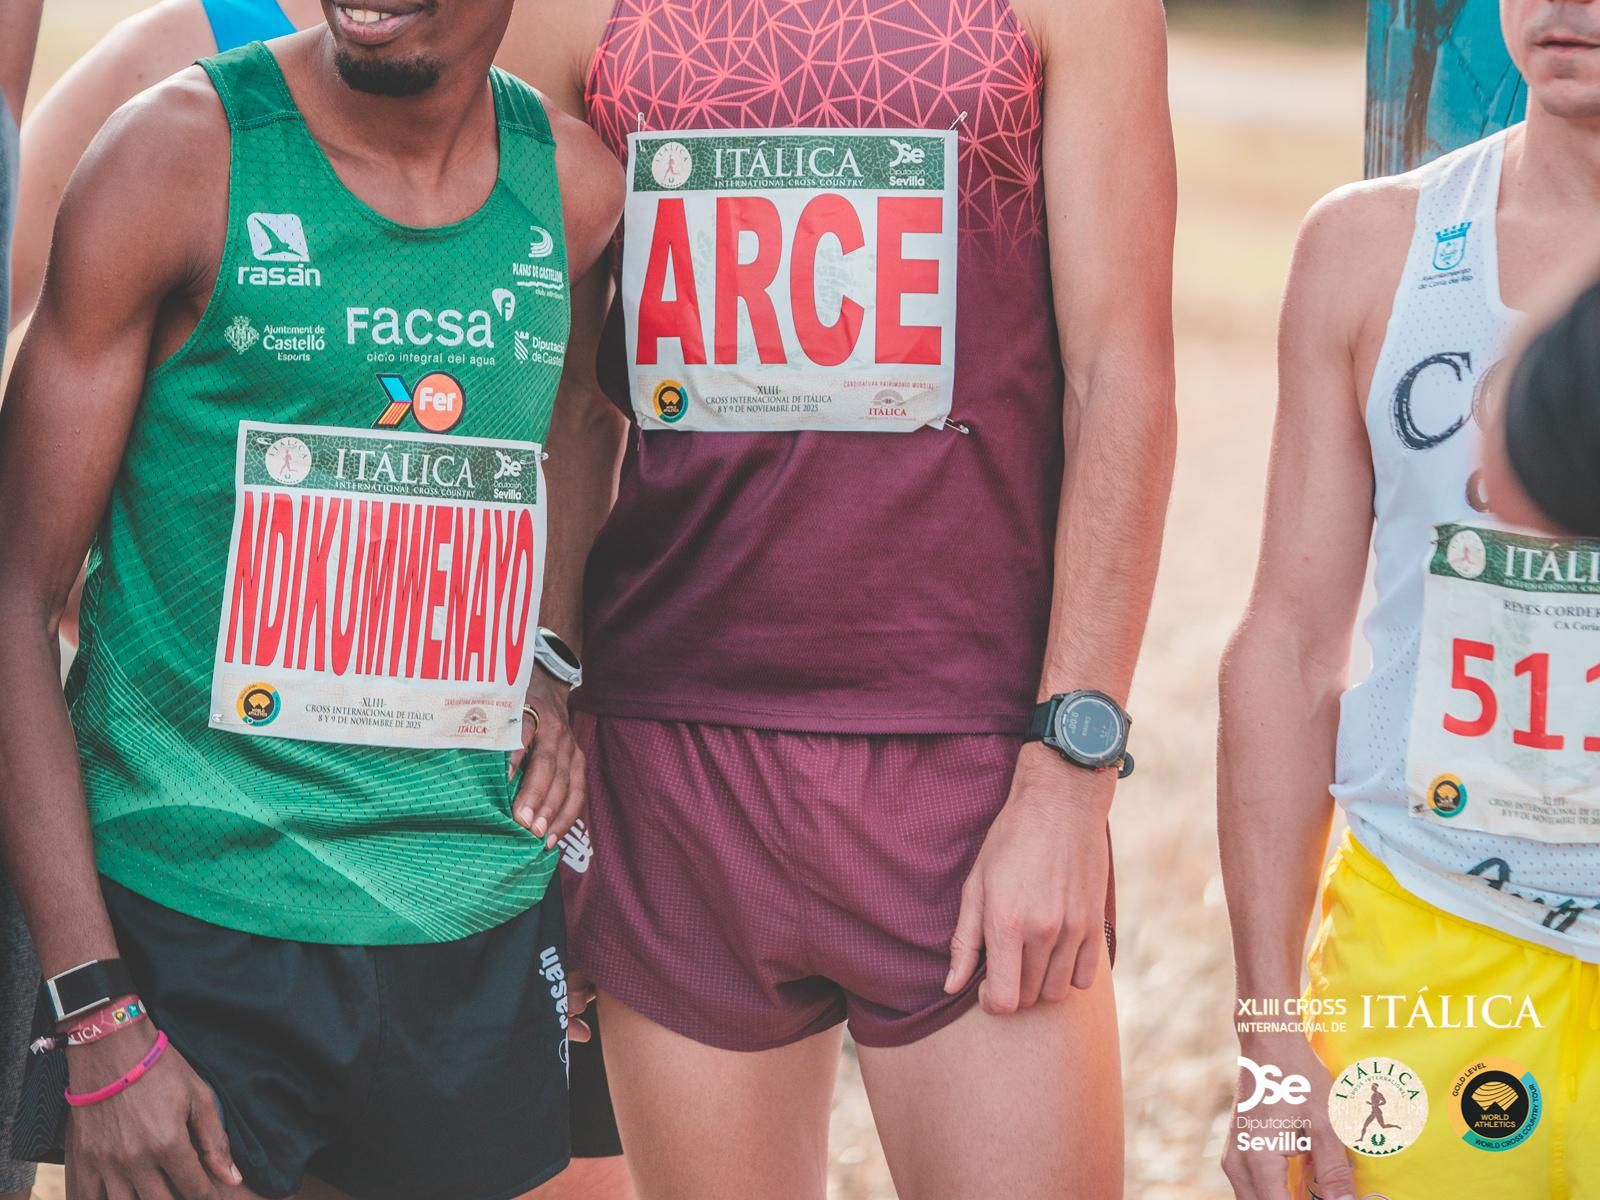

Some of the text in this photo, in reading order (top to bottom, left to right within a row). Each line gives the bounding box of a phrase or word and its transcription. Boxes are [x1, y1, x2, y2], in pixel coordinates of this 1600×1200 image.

[713, 140, 864, 178] ITÁLICA
[714, 178, 864, 188] INTERNATIONAL CROSS COUNTRY
[889, 176, 925, 187] Sevilla
[635, 193, 943, 367] ARCE
[263, 324, 325, 335] Ajuntament de
[262, 334, 326, 351] Castelló
[277, 351, 311, 362] Esports
[366, 352, 496, 367] ciclo integral del agua
[532, 352, 541, 363] de
[419, 387, 457, 412] Fer
[705, 396, 728, 405] CROSS
[730, 395, 789, 404] INTERNACIONAL
[791, 395, 801, 404] DE
[735, 405, 744, 413] DE
[746, 404, 788, 413] NOVIEMBRE
[791, 404, 801, 412] DE
[803, 404, 819, 412] 2025
[334, 443, 475, 489] ITÁLICA
[335, 481, 476, 498] INTERNATIONAL CROSS COUNTRY
[493, 488, 522, 500] Sevilla
[224, 491, 534, 687] NDIKUMWENAYO
[1503, 600, 1540, 615] REYES
[1554, 623, 1569, 631] CA
[305, 703, 331, 714] CROSS
[332, 705, 394, 718] INTERNACIONAL
[396, 711, 406, 719] DE
[350, 718, 394, 728] NOVIEMBRE
[406, 720, 421, 729] 2025
